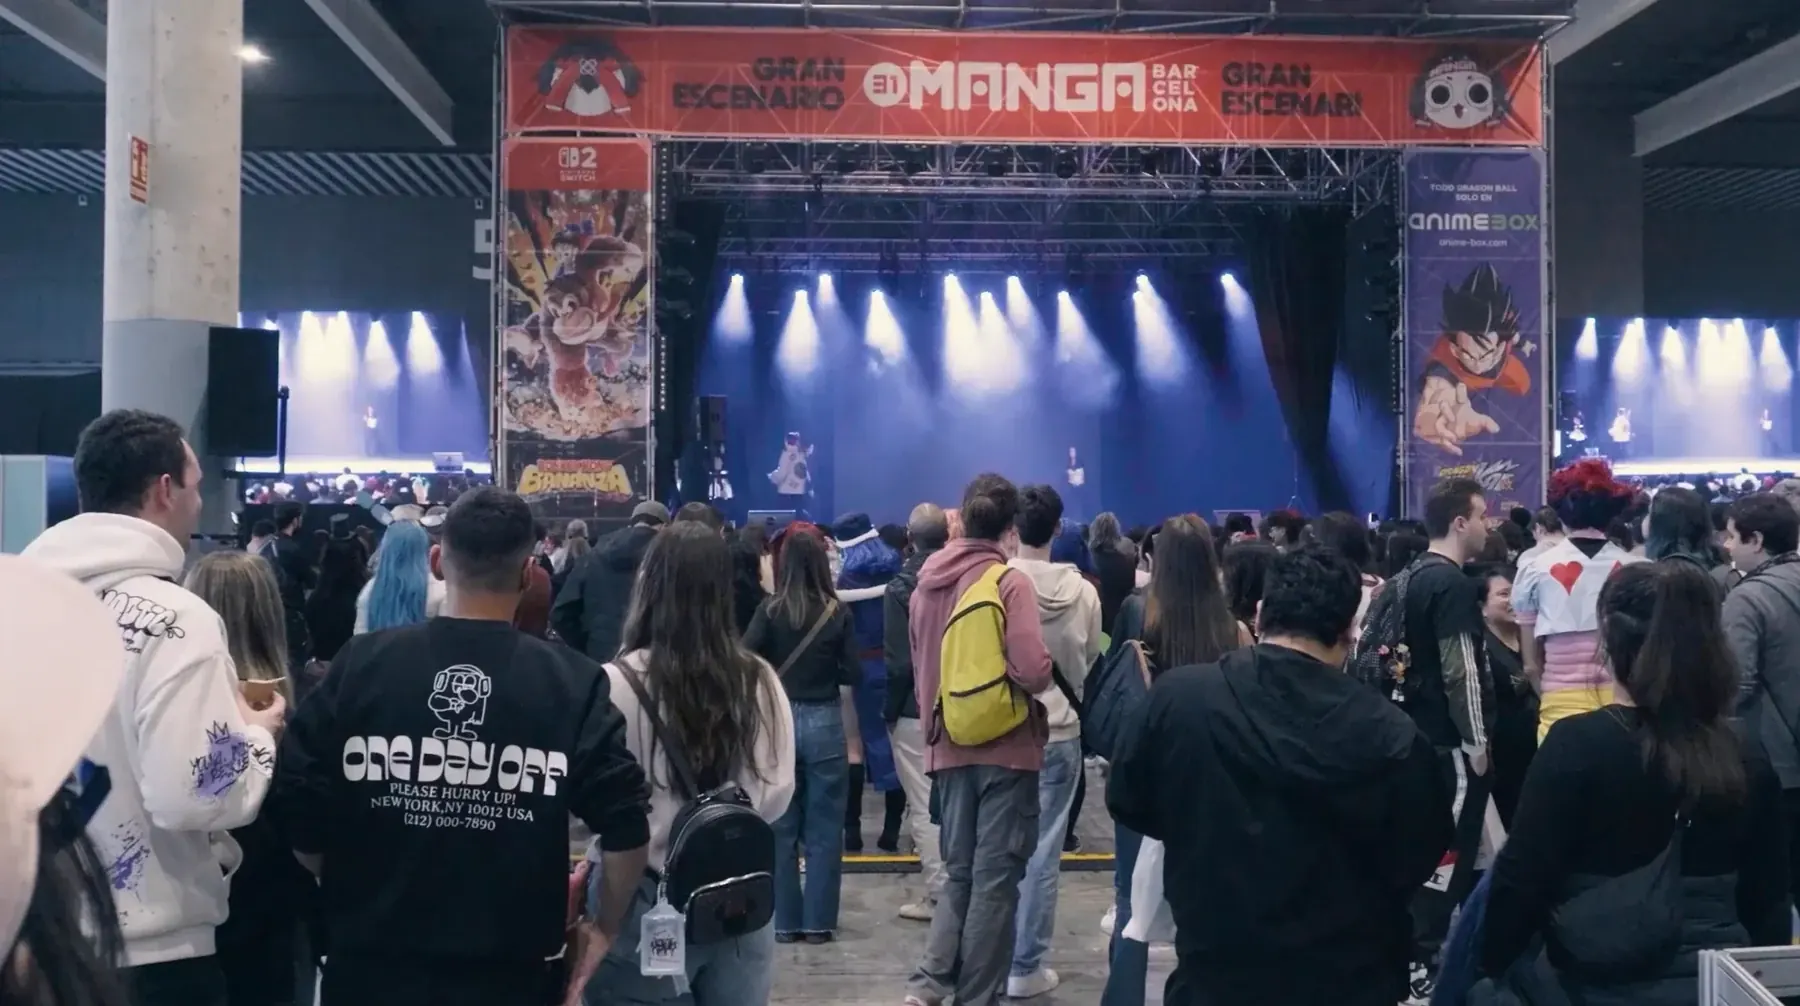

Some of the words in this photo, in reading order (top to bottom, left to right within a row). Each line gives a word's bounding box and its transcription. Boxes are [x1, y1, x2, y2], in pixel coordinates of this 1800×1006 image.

[753, 57, 846, 82] GRAN
[1152, 64, 1197, 79] BAR
[1221, 62, 1312, 88] GRAN
[910, 60, 1146, 113] MANGA
[1152, 81, 1195, 96] CEL
[673, 83, 846, 111] ESCENARIO
[1152, 97, 1198, 112] ONA
[1221, 91, 1363, 118] ESCENARI
[560, 174, 597, 182] SWITCH
[1430, 183, 1455, 192] TODO
[1456, 184, 1494, 192] DRAGON
[1495, 184, 1518, 193] BALL
[1455, 193, 1479, 201] SOLO
[1480, 193, 1493, 201] EN
[1439, 239, 1508, 248] anime-box.com
[516, 464, 633, 496] BANANZA
[389, 782, 439, 798] PLEASE
[441, 787, 491, 802] HURRY
[494, 791, 517, 805] UP!
[404, 812, 433, 828] (212)
[435, 816, 497, 831] 000-7890
[467, 803, 503, 818] 10012
[506, 807, 534, 822] USA
